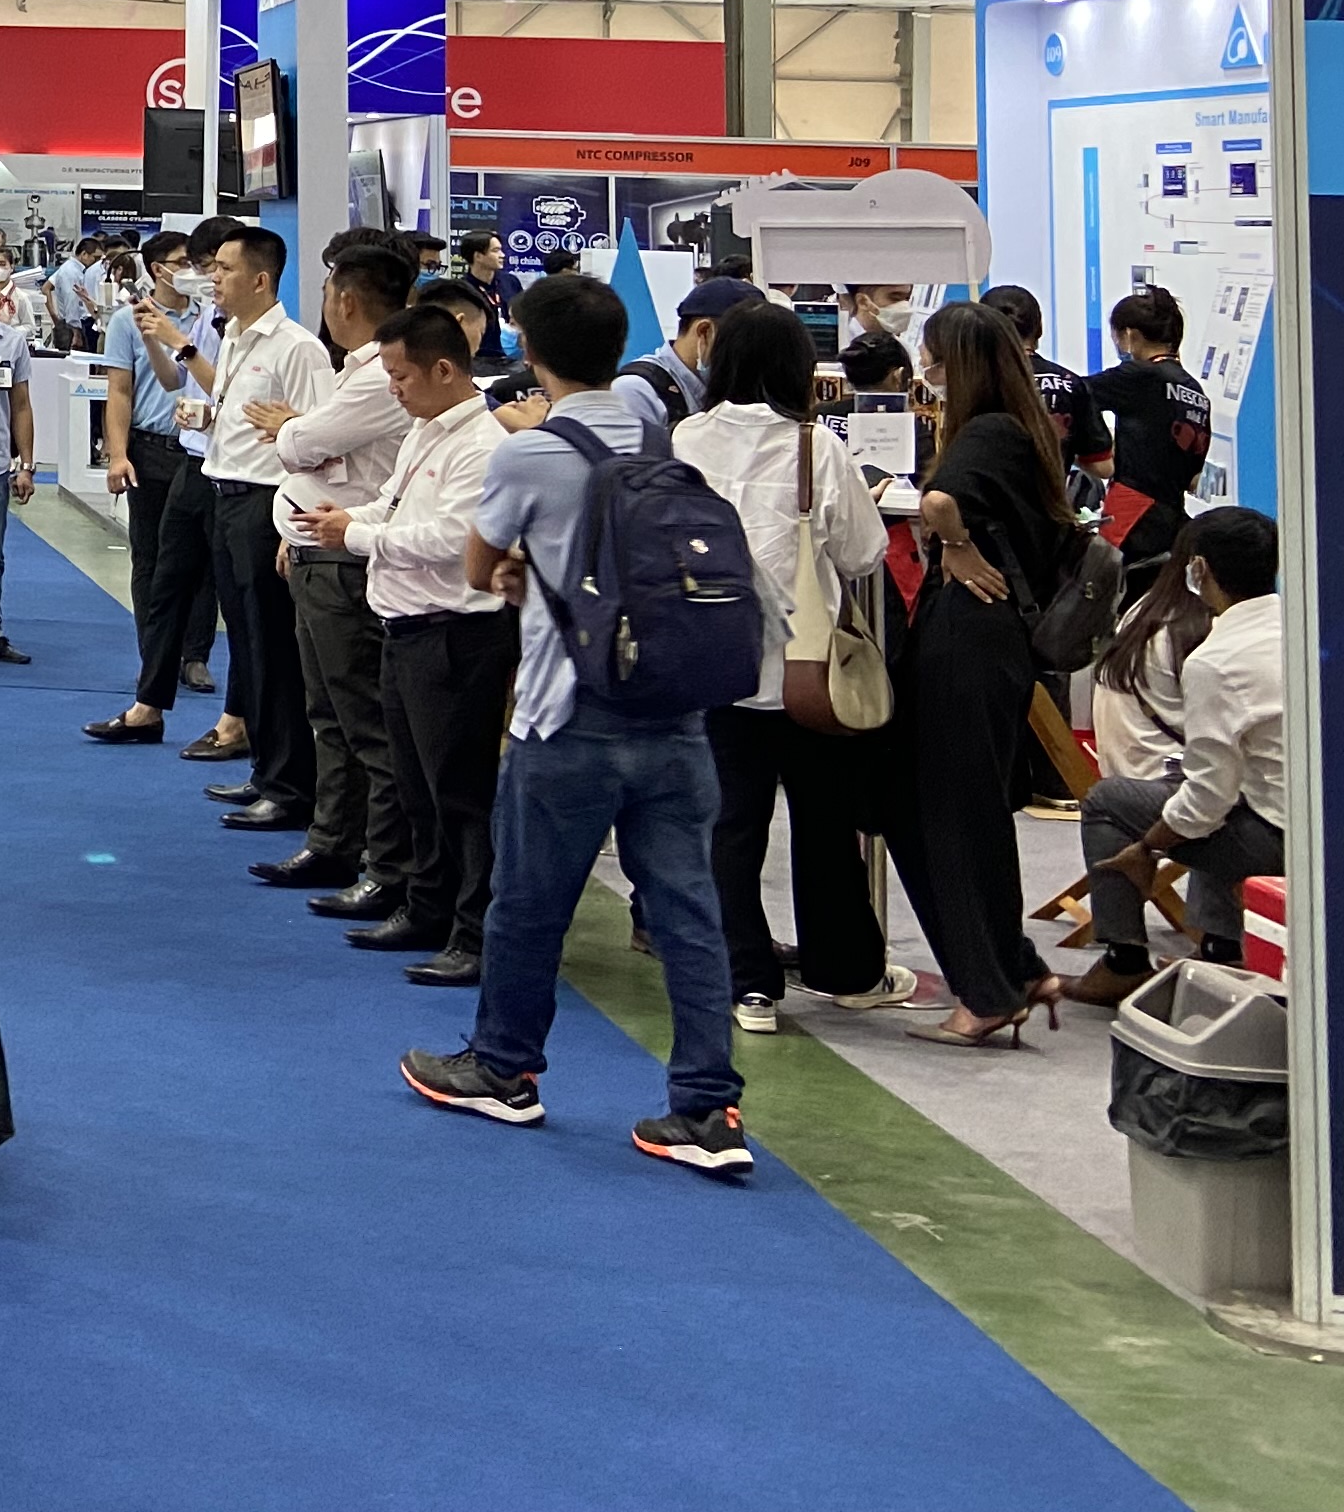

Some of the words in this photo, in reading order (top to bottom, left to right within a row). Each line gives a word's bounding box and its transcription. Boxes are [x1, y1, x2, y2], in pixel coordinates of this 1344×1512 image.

[1195, 111, 1225, 127] Smart
[1228, 107, 1269, 125] Manufa
[576, 149, 602, 160] NTC
[605, 150, 694, 163] COMPRESSOR
